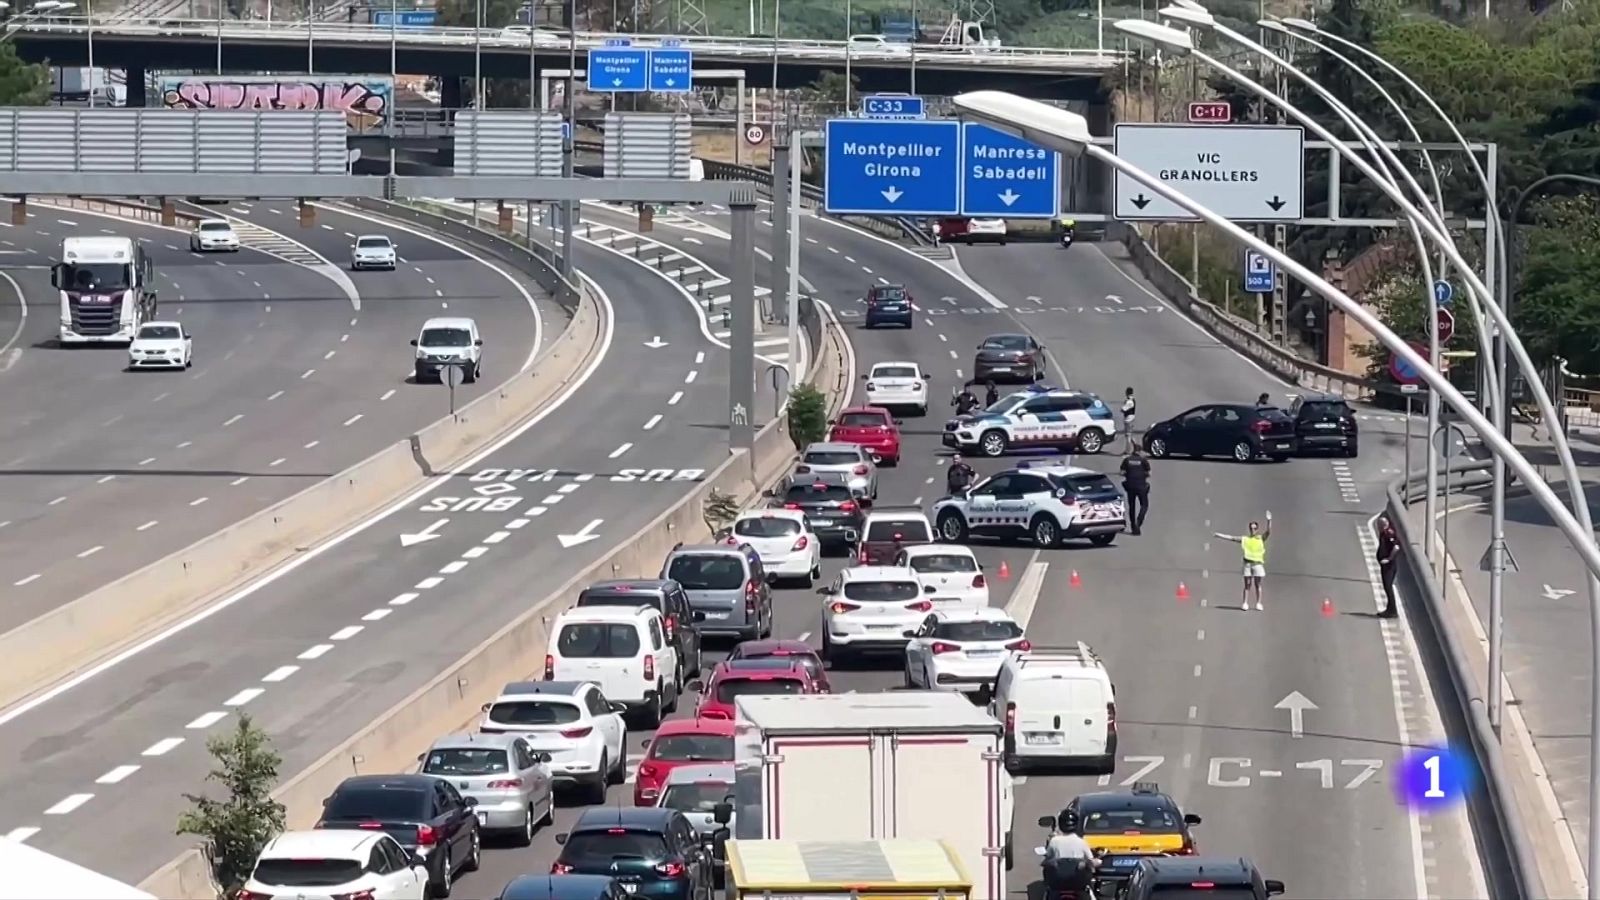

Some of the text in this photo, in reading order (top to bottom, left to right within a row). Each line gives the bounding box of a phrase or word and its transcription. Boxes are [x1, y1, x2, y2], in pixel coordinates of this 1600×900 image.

[604, 65, 631, 73] Girona
[868, 100, 904, 112] C-33
[1195, 105, 1224, 117] C-17
[749, 130, 761, 138] 80
[843, 142, 942, 159] Montpellier
[973, 144, 1046, 160] Manresa
[1197, 153, 1221, 164] VIC
[864, 163, 921, 178] Girona
[972, 165, 1047, 181] Sabadell
[1159, 169, 1259, 182] GRANOLLERS
[608, 468, 705, 482] BUS
[418, 496, 524, 512] BUS
[1207, 756, 1384, 789] C-17
